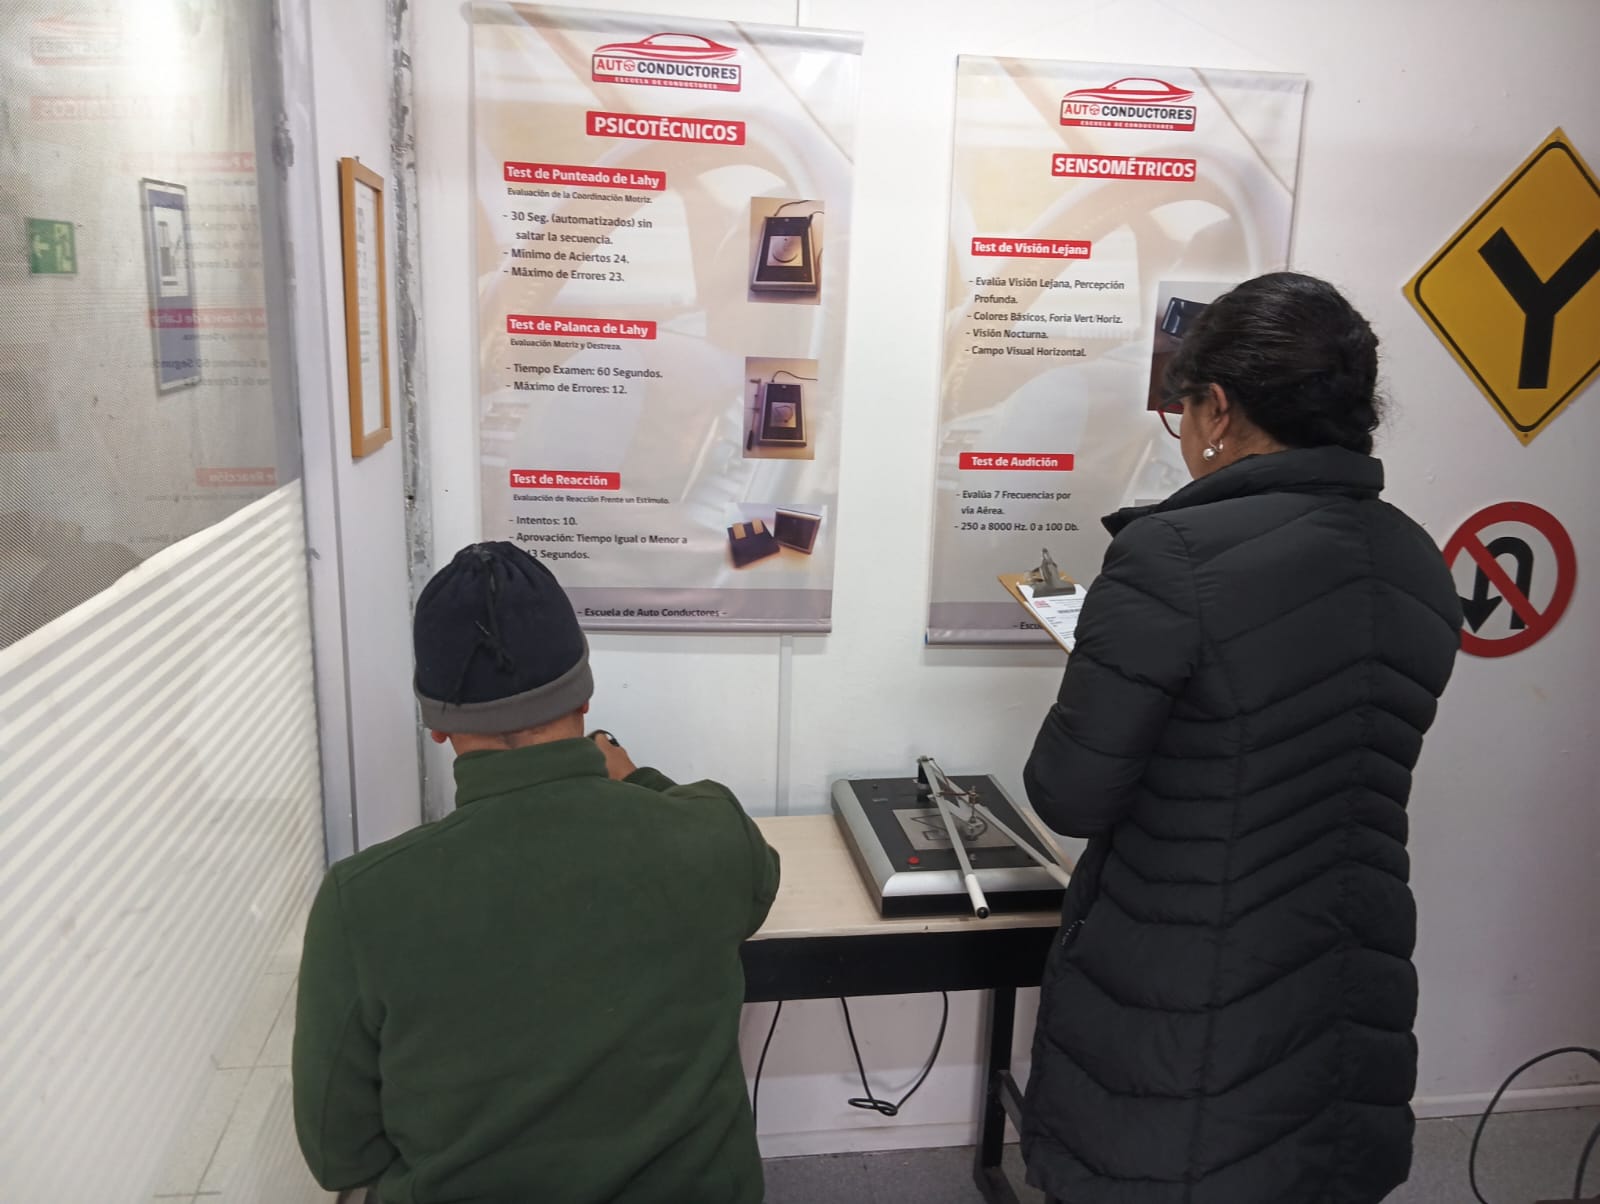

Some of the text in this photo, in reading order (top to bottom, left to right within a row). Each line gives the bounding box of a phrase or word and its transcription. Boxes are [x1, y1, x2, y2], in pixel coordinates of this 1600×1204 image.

[638, 60, 738, 80] CONDUCTORES
[614, 76, 718, 90] ESCUELA DE CONDUCTORES
[1102, 104, 1192, 120] CONDUCTORES
[594, 116, 738, 142] PSICOTÉCNICOS
[1080, 120, 1111, 128] ESCUELA
[1124, 122, 1174, 130] CONDUCTORES
[1054, 156, 1194, 178] SENSOMÉTRICOS
[506, 166, 660, 188] Test de Punteado de Lahy
[508, 188, 652, 204] Evaluación de la Coordinación Motriz.
[510, 210, 524, 222] 30
[527, 212, 550, 224] Seg.
[552, 212, 635, 228] (automatizados)
[638, 218, 653, 228] sin
[516, 230, 614, 244] saltar la secuencia.
[974, 242, 1089, 256] Test de Visión Lejana
[554, 251, 567, 261] de
[568, 250, 611, 264] Aciertos
[614, 254, 630, 264] 24.
[512, 266, 553, 278] Máximo
[556, 269, 568, 280] de
[570, 270, 606, 282] Errores
[608, 272, 625, 282] 23.
[975, 276, 1006, 287] Evalúa
[1008, 278, 1038, 288] Visión
[1040, 279, 1072, 290] Lejana,
[1074, 280, 1124, 292] Percepción
[974, 294, 1018, 304] Profunda.
[973, 312, 1008, 322] Colores
[1010, 312, 1048, 323] Básicos,
[1050, 312, 1072, 322] Foria
[510, 319, 648, 338] Test de Palanca de Lahy
[972, 328, 1002, 338] Visión
[1003, 330, 1048, 340] Nocturna.
[510, 338, 622, 350] Evaluación Motriz y Destreza.
[971, 346, 1004, 356] Campo
[1006, 346, 1034, 356] Visual
[1036, 348, 1087, 358] Horizontal.
[514, 363, 551, 376] Tiempo
[552, 364, 596, 376] Examen:
[597, 366, 610, 376] 60
[612, 367, 662, 380] Segundos.
[514, 380, 554, 392] Máximo
[558, 382, 570, 392] de
[572, 383, 610, 394] Errores:
[612, 384, 628, 394] 12.
[970, 456, 1058, 468] Test de Audición
[512, 474, 608, 486] Test de Reacción
[513, 494, 554, 502] Evaluación
[555, 494, 564, 502] de
[566, 494, 600, 504] Reacción
[600, 496, 624, 504] Frente
[626, 496, 635, 504] un
[962, 490, 992, 500] Evalúa
[994, 490, 1000, 500] 7
[1002, 490, 1054, 500] Frecuencias
[1056, 493, 1072, 502] por
[961, 506, 1005, 515] vía Aérea.
[516, 516, 560, 526] Intentos:
[562, 516, 578, 526] 10.
[960, 522, 978, 531] 250
[988, 522, 1012, 531] 8000
[1014, 522, 1028, 532] Hz.
[1030, 522, 1036, 532] 0
[1037, 524, 1044, 532] a
[1046, 522, 1062, 532] 100
[1064, 522, 1080, 532] Db.
[516, 532, 574, 544] Aprovación:
[576, 534, 612, 544] Tiempo
[614, 534, 638, 546] Igual
[640, 536, 646, 544] o
[648, 534, 680, 544] Menor
[540, 549, 590, 562] Segundos.
[584, 608, 620, 617] Escuela
[622, 608, 634, 617] de
[638, 608, 660, 617] Auto
[660, 608, 720, 618] Conductores
